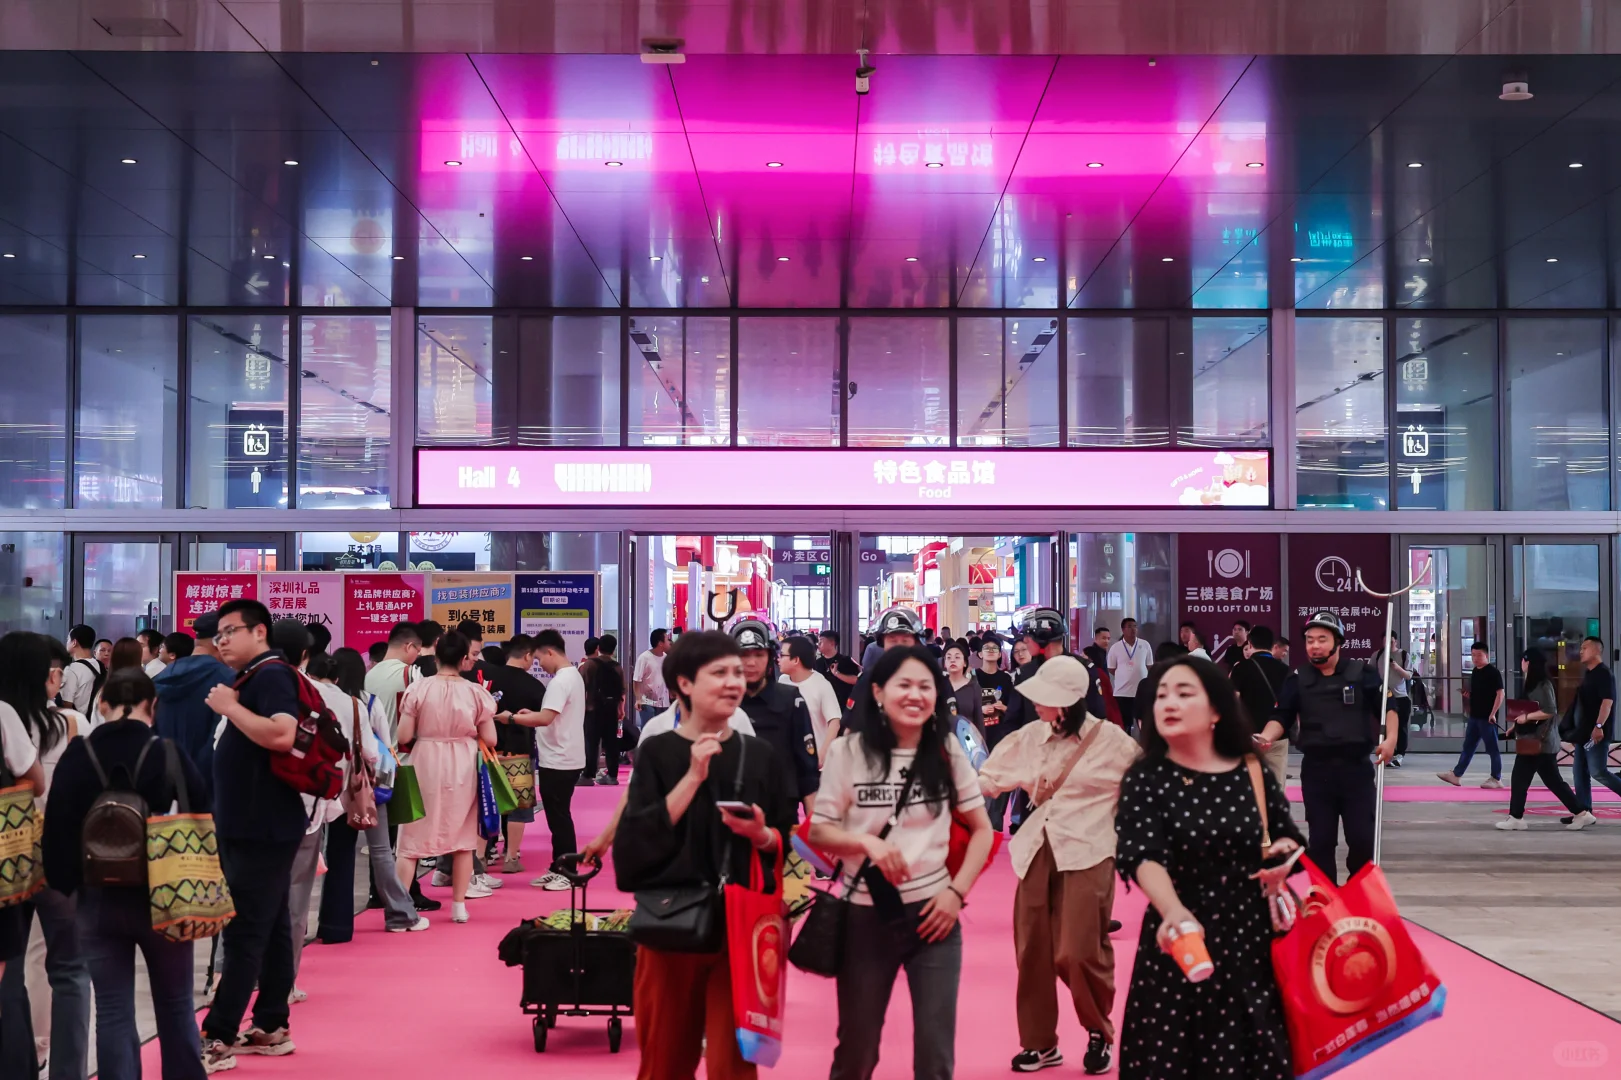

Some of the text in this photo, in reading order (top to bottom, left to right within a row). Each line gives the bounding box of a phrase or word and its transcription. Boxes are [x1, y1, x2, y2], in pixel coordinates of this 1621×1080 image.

[458, 465, 521, 489] Hall 4
[873, 459, 996, 485] 特色食品馆
[918, 485, 952, 498] Food
[782, 551, 818, 561] 外卖区
[861, 551, 877, 561] Go
[269, 581, 320, 595] 深圳礼品
[1337, 577, 1352, 592] 24
[185, 584, 243, 599] 解锁惊喜
[1185, 586, 1274, 601] 三楼美食广场
[269, 597, 307, 610] 家居展
[356, 601, 414, 611] 上礼贸通APP
[1187, 605, 1271, 613] FOOD LOFT ON L3
[448, 609, 495, 622] 到6号馆
